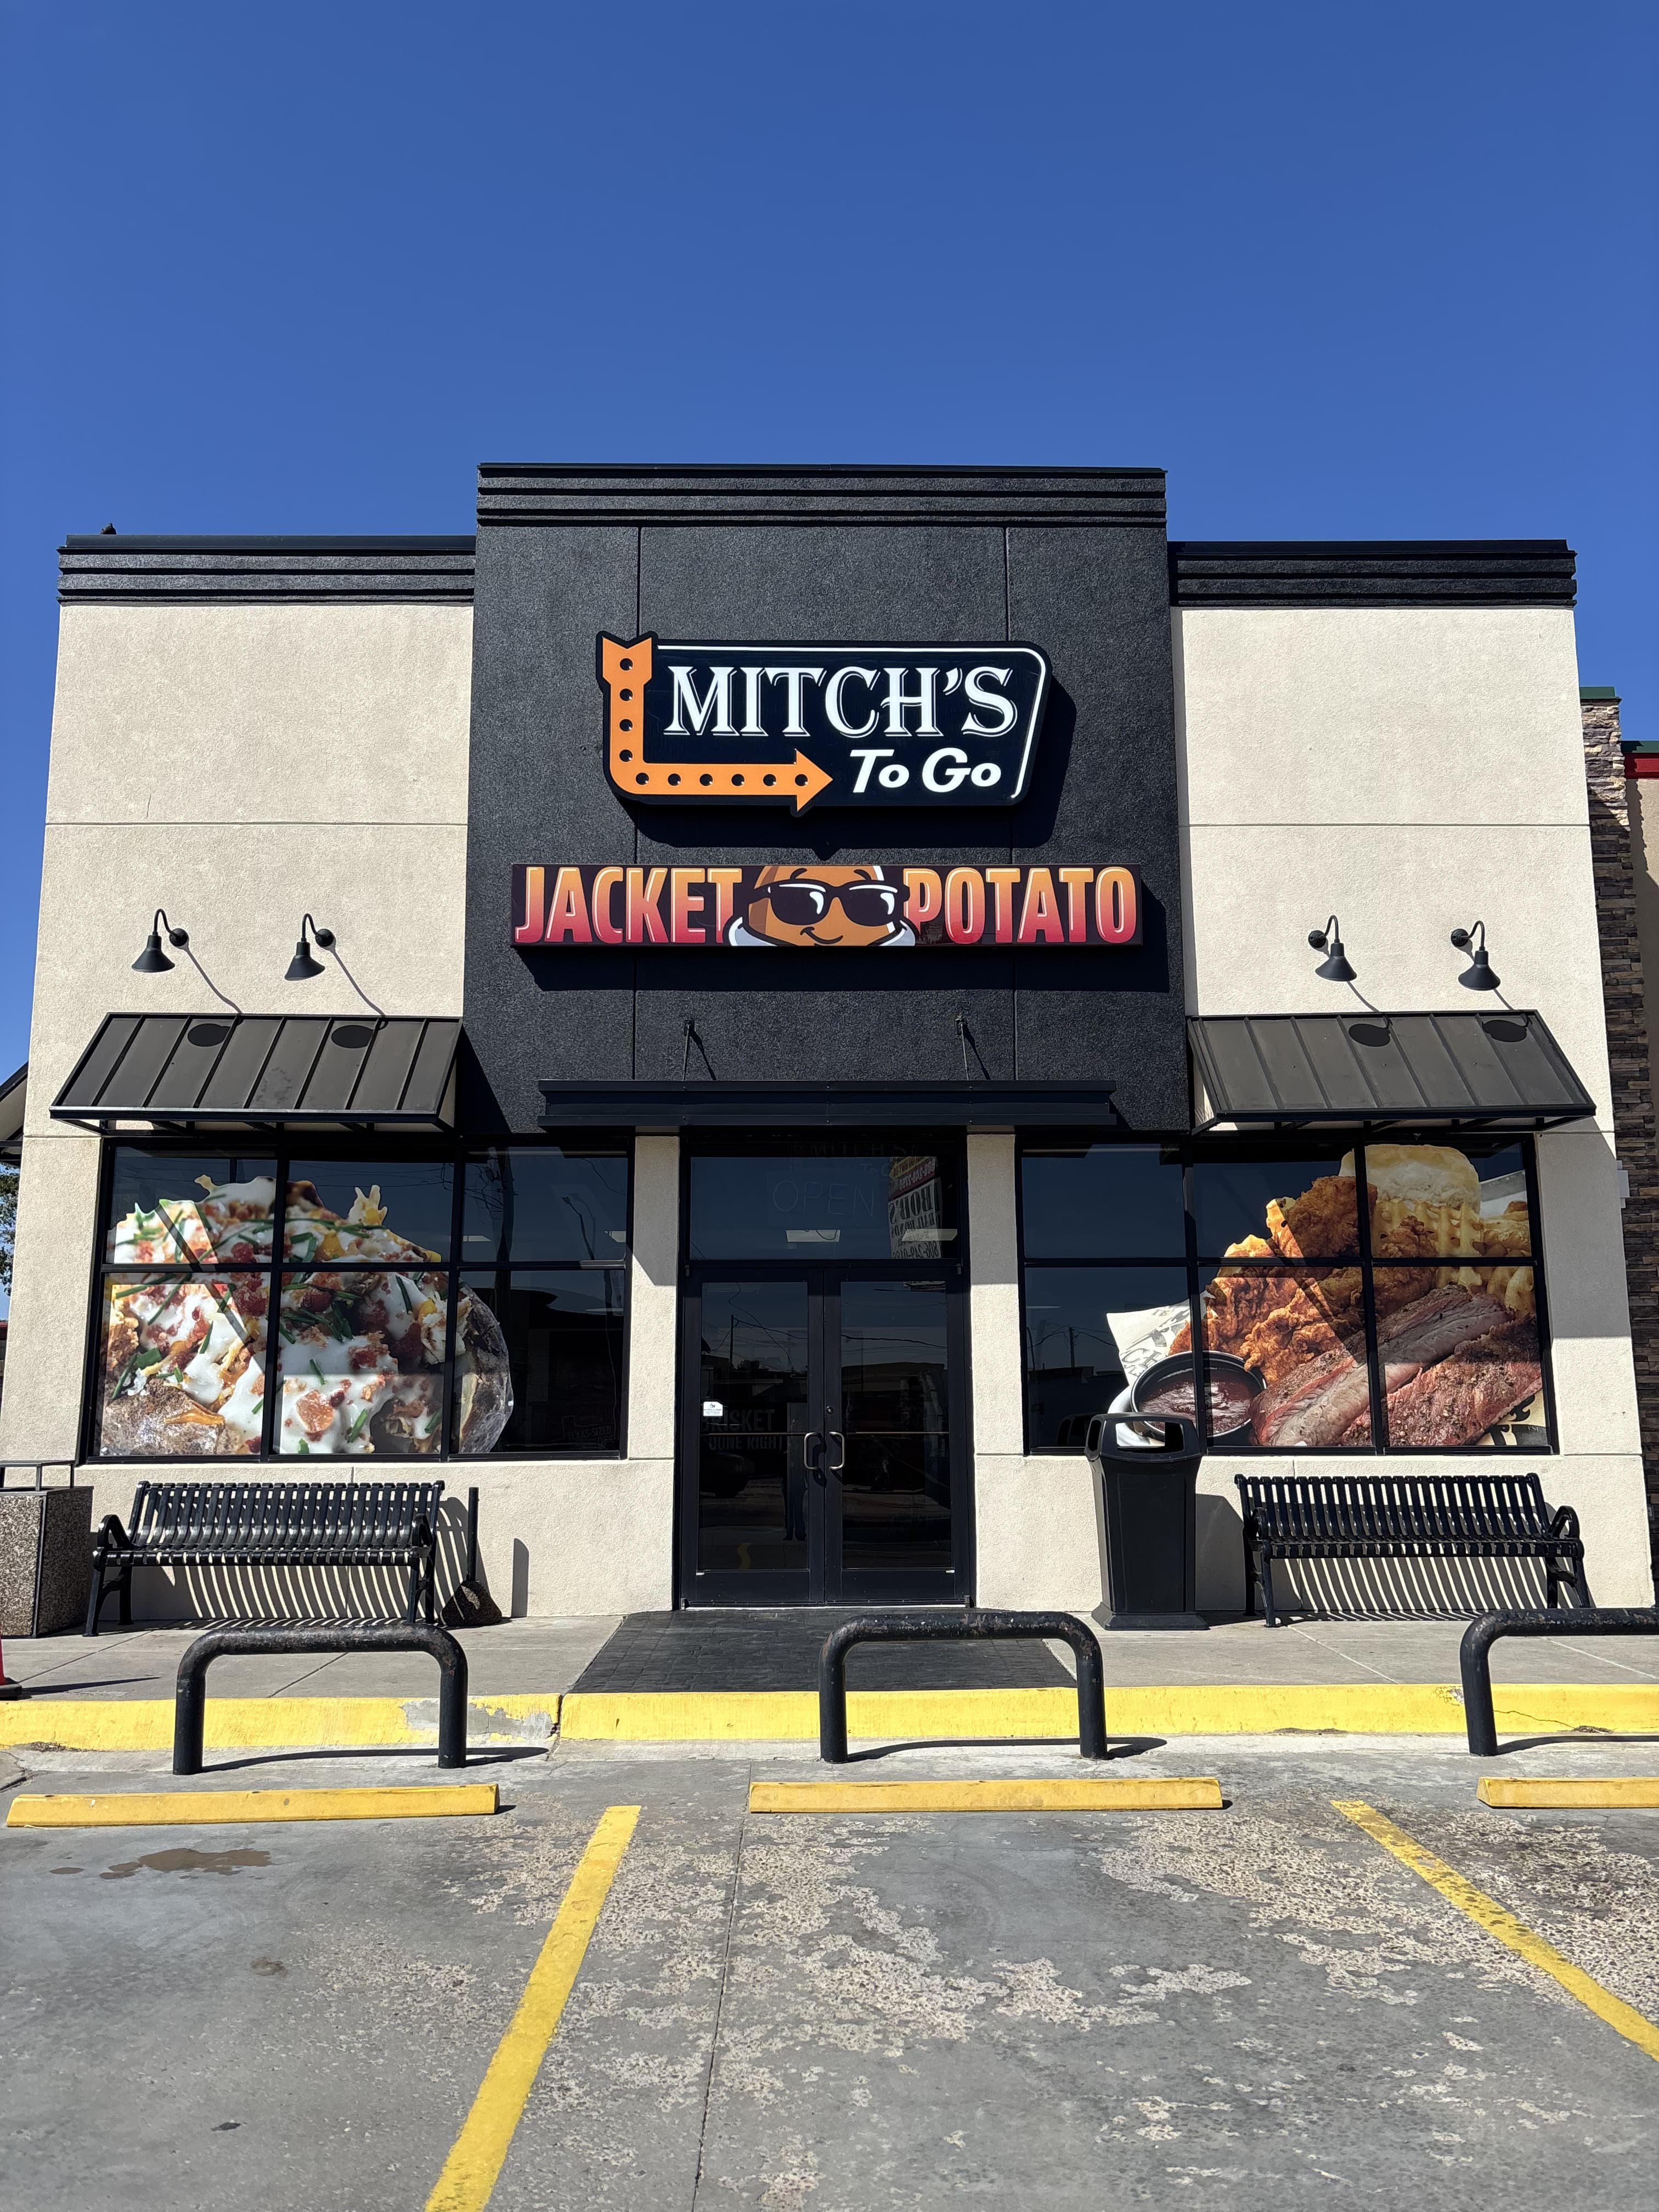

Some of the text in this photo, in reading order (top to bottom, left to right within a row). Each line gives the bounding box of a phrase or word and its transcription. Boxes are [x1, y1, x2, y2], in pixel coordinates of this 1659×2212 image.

[663, 665, 1018, 738] MITCH'S
[850, 747, 1002, 793] To Go
[515, 866, 1138, 944] JACKET POTATO
[772, 1180, 874, 1217] OPEN
[702, 1409, 775, 1431] RISKET
